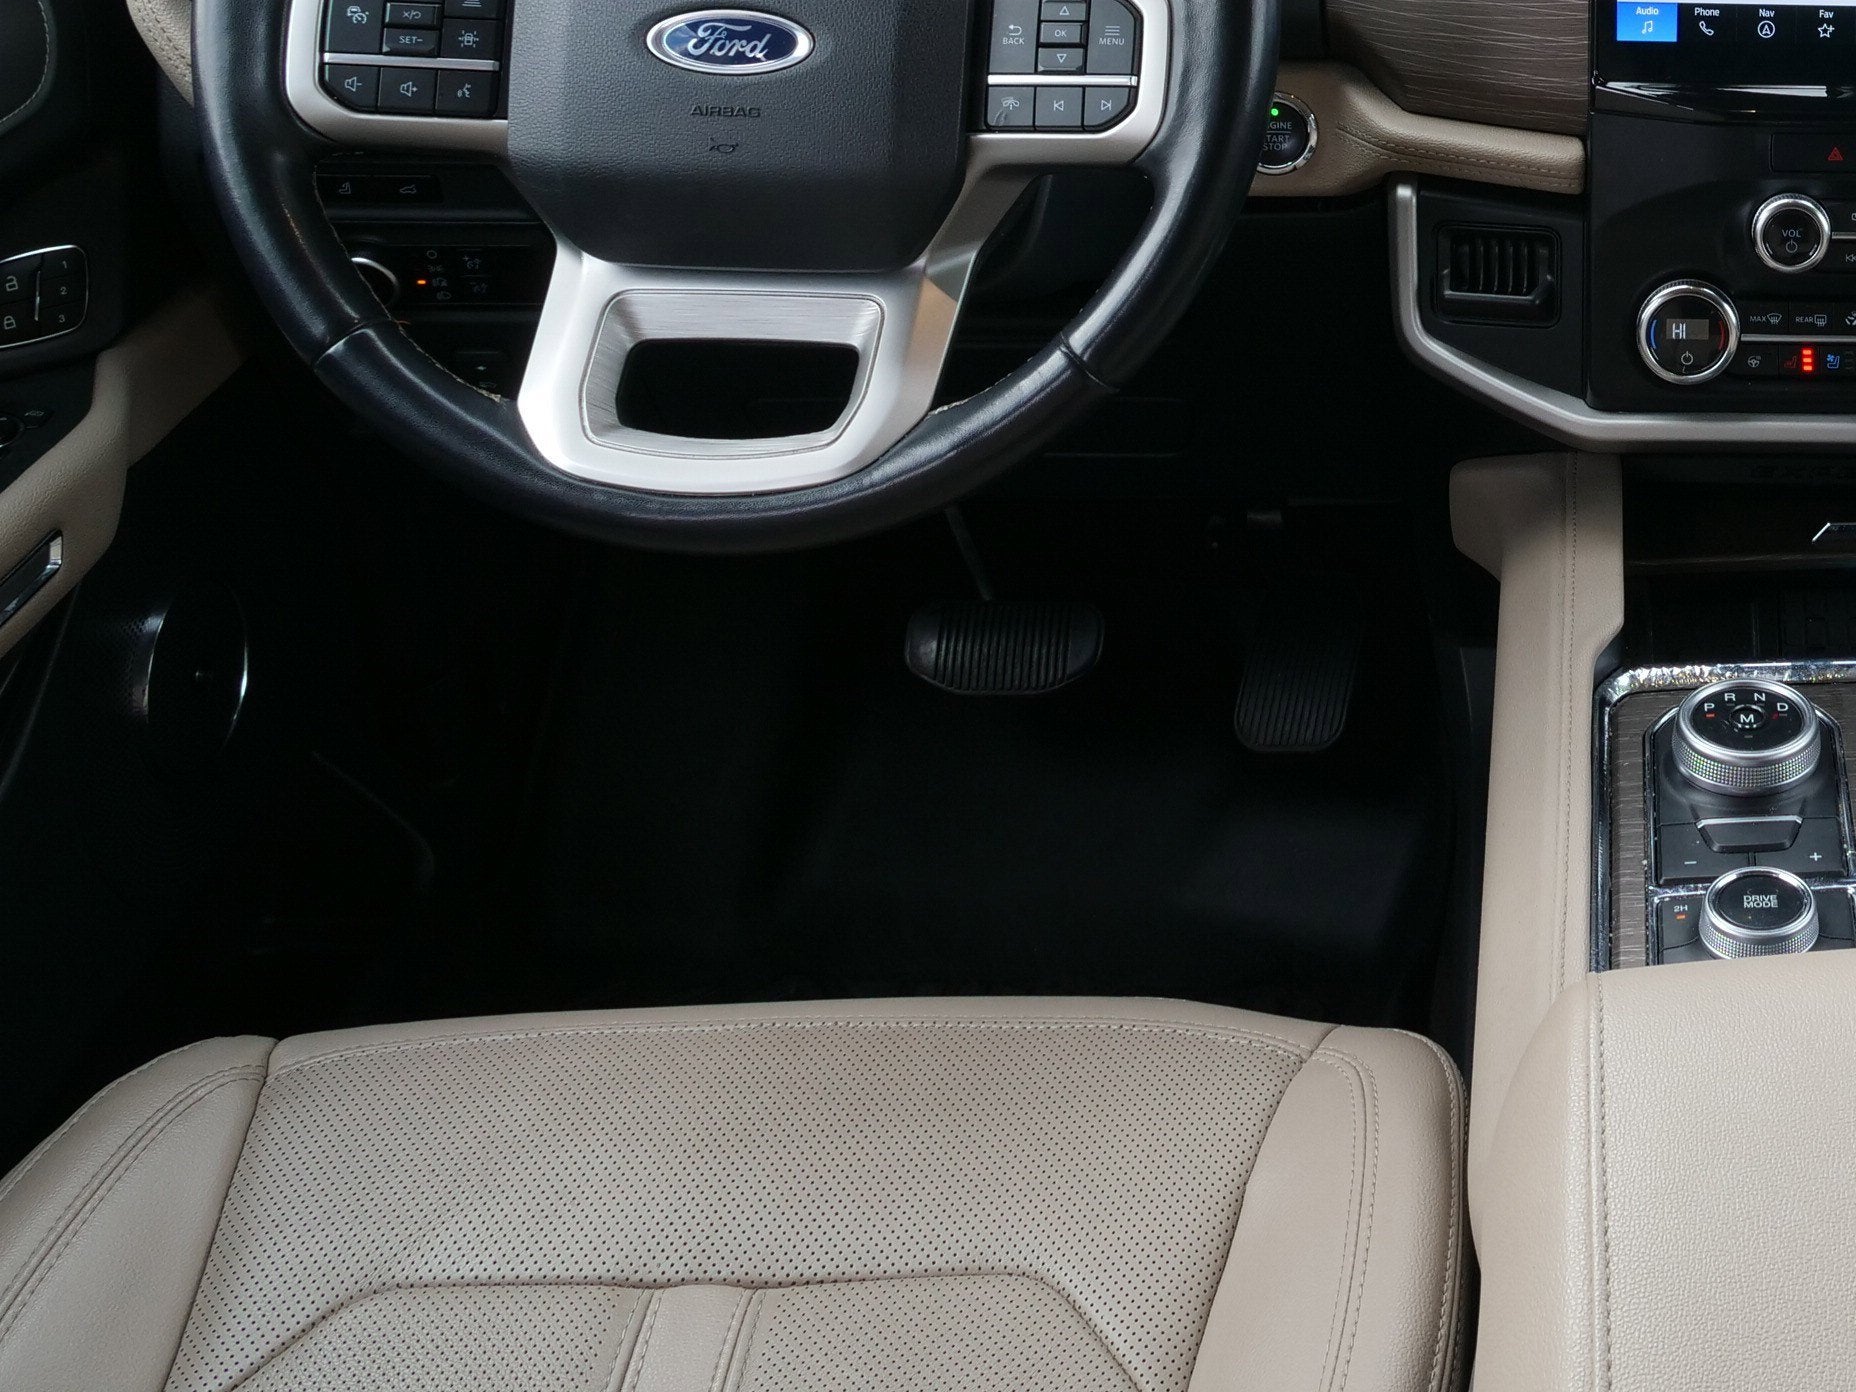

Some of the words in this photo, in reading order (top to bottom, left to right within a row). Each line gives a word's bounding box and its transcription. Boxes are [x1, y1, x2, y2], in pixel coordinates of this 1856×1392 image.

[1636, 6, 1659, 16] Audio
[1694, 7, 1720, 17] Phone
[1759, 8, 1775, 18] Nav
[1819, 9, 1834, 19] Fav
[1054, 29, 1068, 38] OK
[687, 22, 772, 61] Ford
[1002, 36, 1025, 46] BACK
[1099, 37, 1125, 46] MENU
[691, 105, 761, 119] AIRBAG
[1266, 121, 1292, 131] GINE
[1264, 134, 1290, 143] TART
[1781, 228, 1801, 238] VOL
[60, 286, 67, 295] 2
[59, 314, 66, 323] 3
[1750, 315, 1766, 323] MAX
[1671, 322, 1687, 340] HI
[1724, 692, 1737, 702] R
[1753, 693, 1766, 702] N
[1704, 703, 1715, 712] P
[1777, 702, 1789, 712] D
[1740, 713, 1755, 723] M
[1743, 894, 1778, 902] DRIVE
[1673, 904, 1689, 912] 2H
